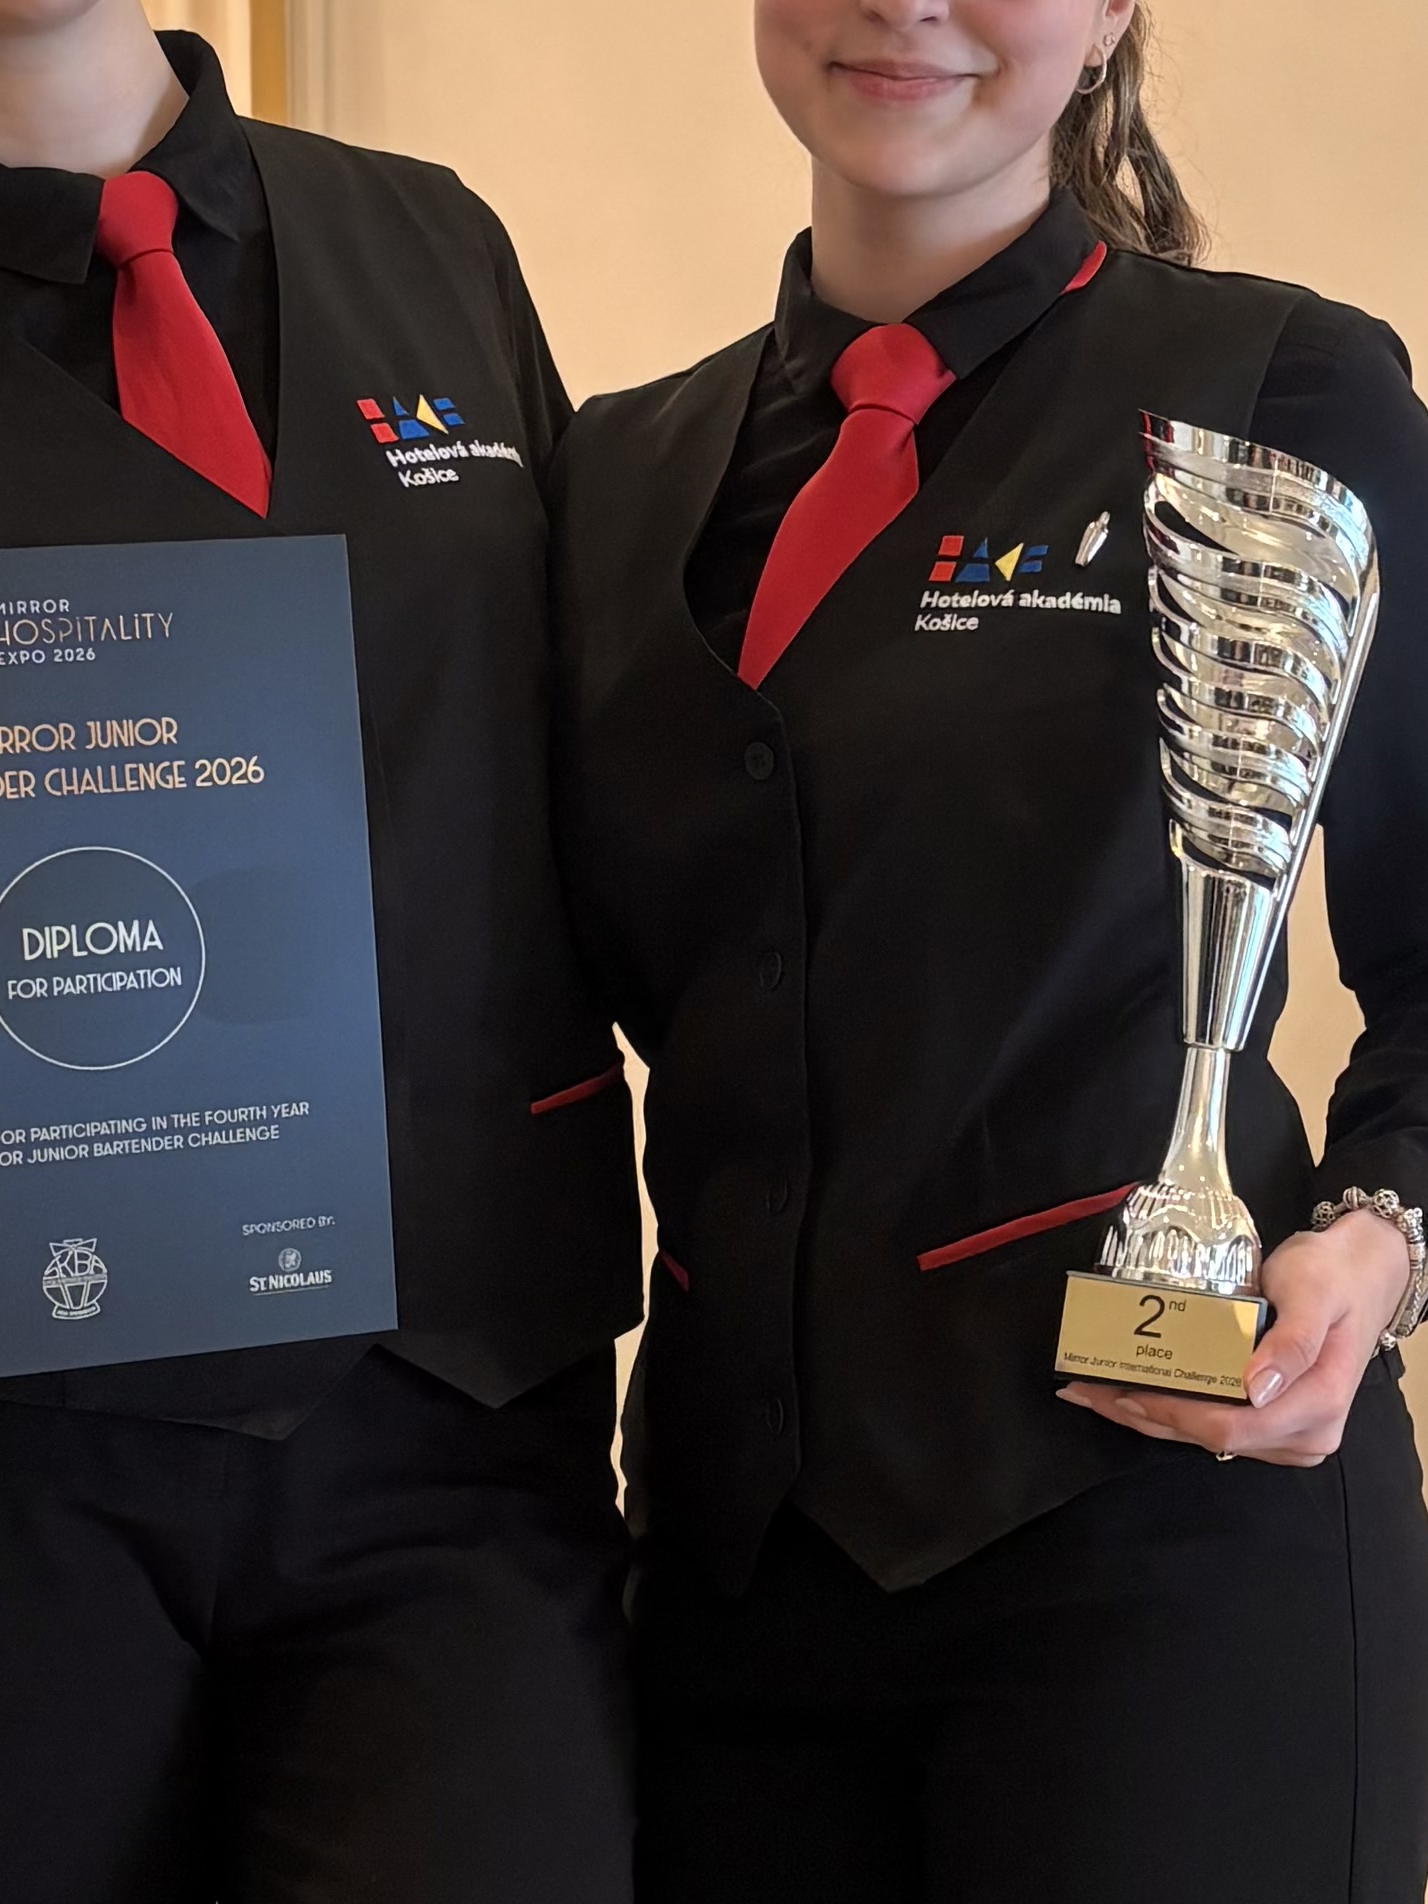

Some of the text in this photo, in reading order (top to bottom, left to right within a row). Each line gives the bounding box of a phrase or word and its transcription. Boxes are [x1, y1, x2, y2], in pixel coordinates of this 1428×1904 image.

[385, 440, 469, 468] Hotelová
[398, 467, 460, 488] Košice
[920, 589, 1122, 615] Hotelová akadémia
[914, 613, 980, 631] Košice
[53, 647, 97, 663] 2026
[85, 716, 179, 751] JUNIOR
[43, 759, 188, 797] CHALLENGE
[194, 755, 266, 788] 2026
[22, 919, 165, 961] DIPLOMA
[7, 966, 183, 1000] FOR PARTICIPATION
[30, 1117, 147, 1143] PARTICIPATING
[151, 1115, 168, 1131] IN
[171, 1112, 201, 1129] THE
[204, 1105, 268, 1126] FOURTH
[270, 1101, 310, 1119] YEAR
[27, 1144, 89, 1165] JUNIOR
[93, 1135, 184, 1157] BARTENDER
[187, 1124, 280, 1148] CHALLENGE
[242, 1217, 316, 1236] SPONSORED
[268, 1269, 332, 1290] NICOLAUS
[1135, 1343, 1174, 1360] place
[1174, 1368, 1218, 1386] Challenge
